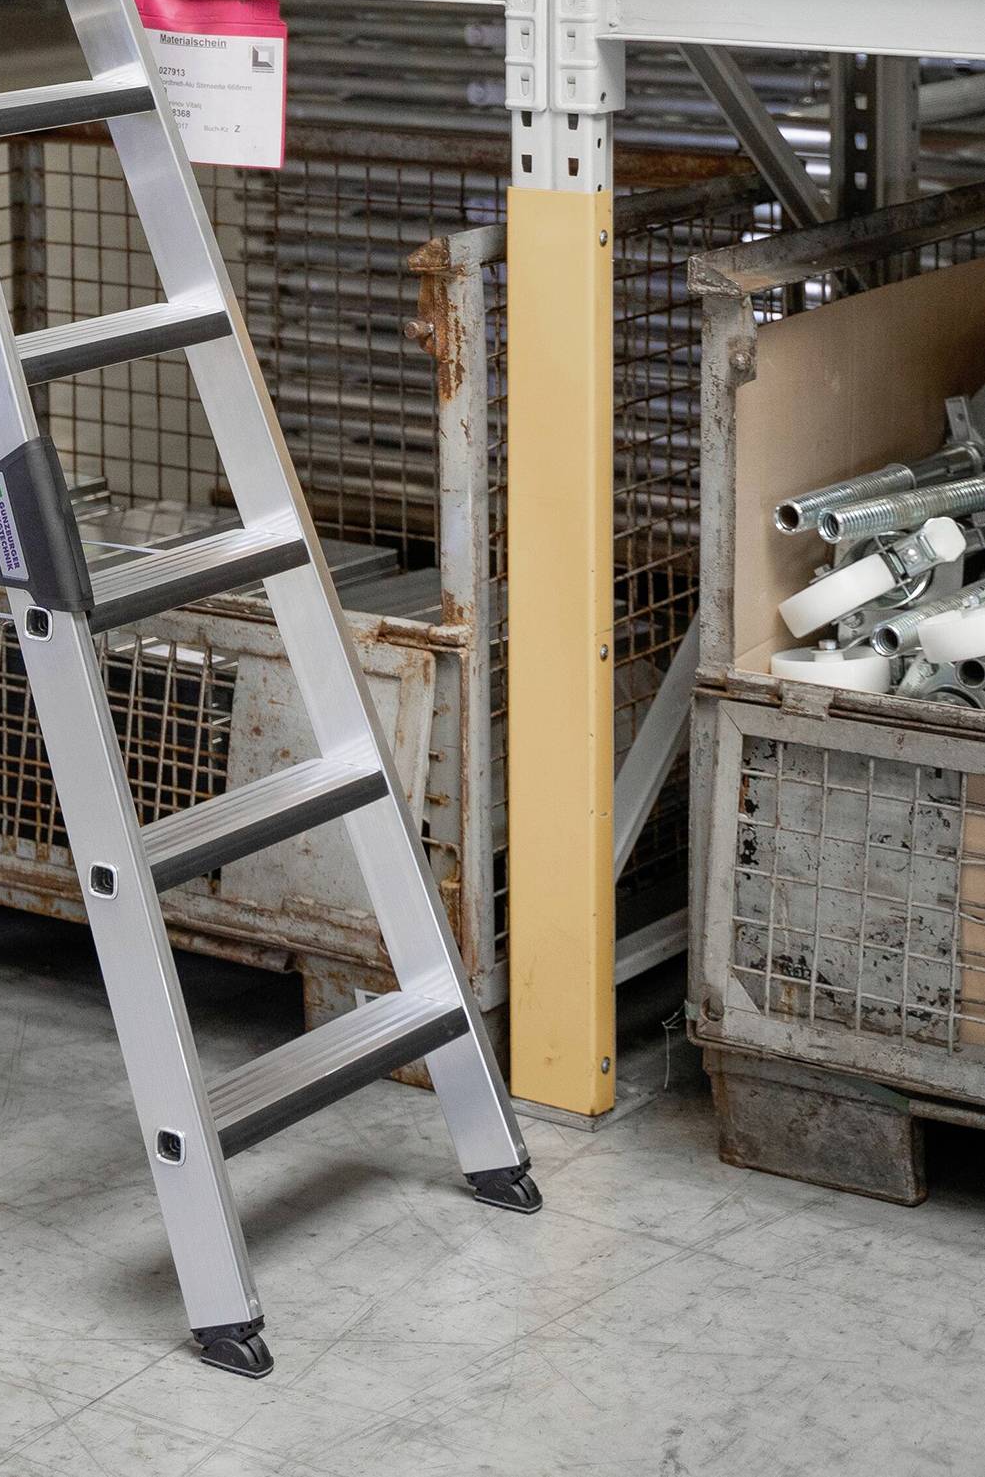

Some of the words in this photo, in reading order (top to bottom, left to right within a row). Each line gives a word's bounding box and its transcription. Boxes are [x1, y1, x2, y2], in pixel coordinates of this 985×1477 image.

[159, 33, 227, 49] Materialschein
[158, 65, 186, 77] 027913
[233, 124, 241, 133] Z
